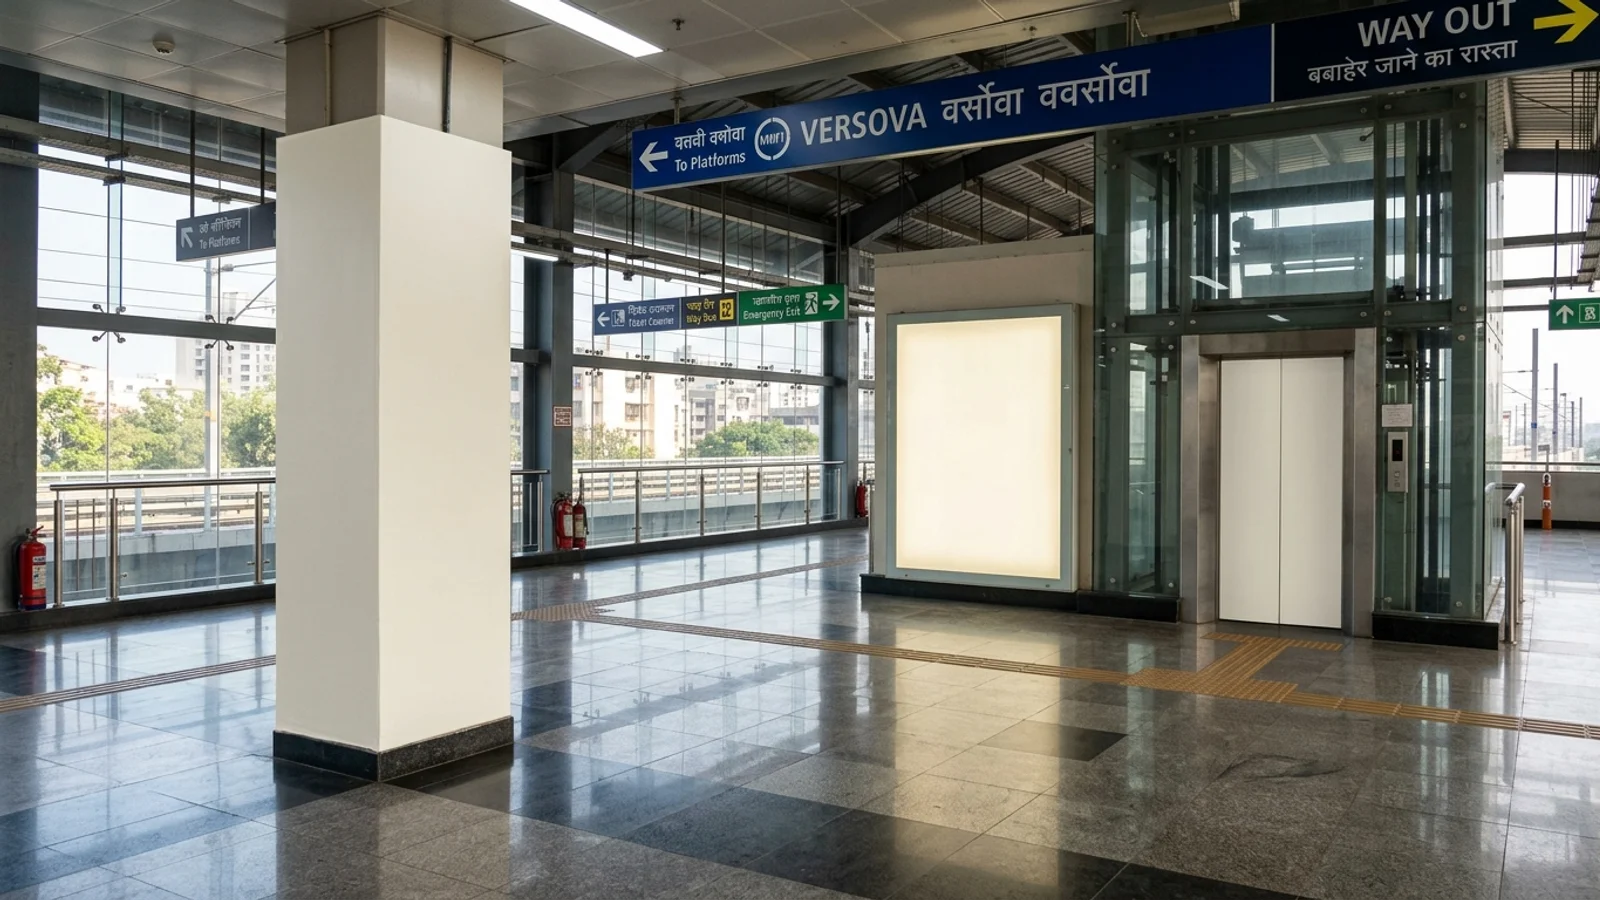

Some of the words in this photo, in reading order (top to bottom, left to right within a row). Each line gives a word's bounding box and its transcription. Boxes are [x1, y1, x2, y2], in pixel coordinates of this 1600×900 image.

[1357, 10, 1434, 48] WAY
[1444, 0, 1516, 35] OUT
[1306, 56, 1369, 84] बबाहेर
[1374, 48, 1419, 74] जाने
[1424, 48, 1454, 68] का
[1459, 39, 1519, 64] रास्ता
[800, 102, 928, 146] VERSOVA
[940, 81, 1025, 125] वर्सोवा
[674, 158, 688, 172] To
[690, 152, 746, 170] Platforms
